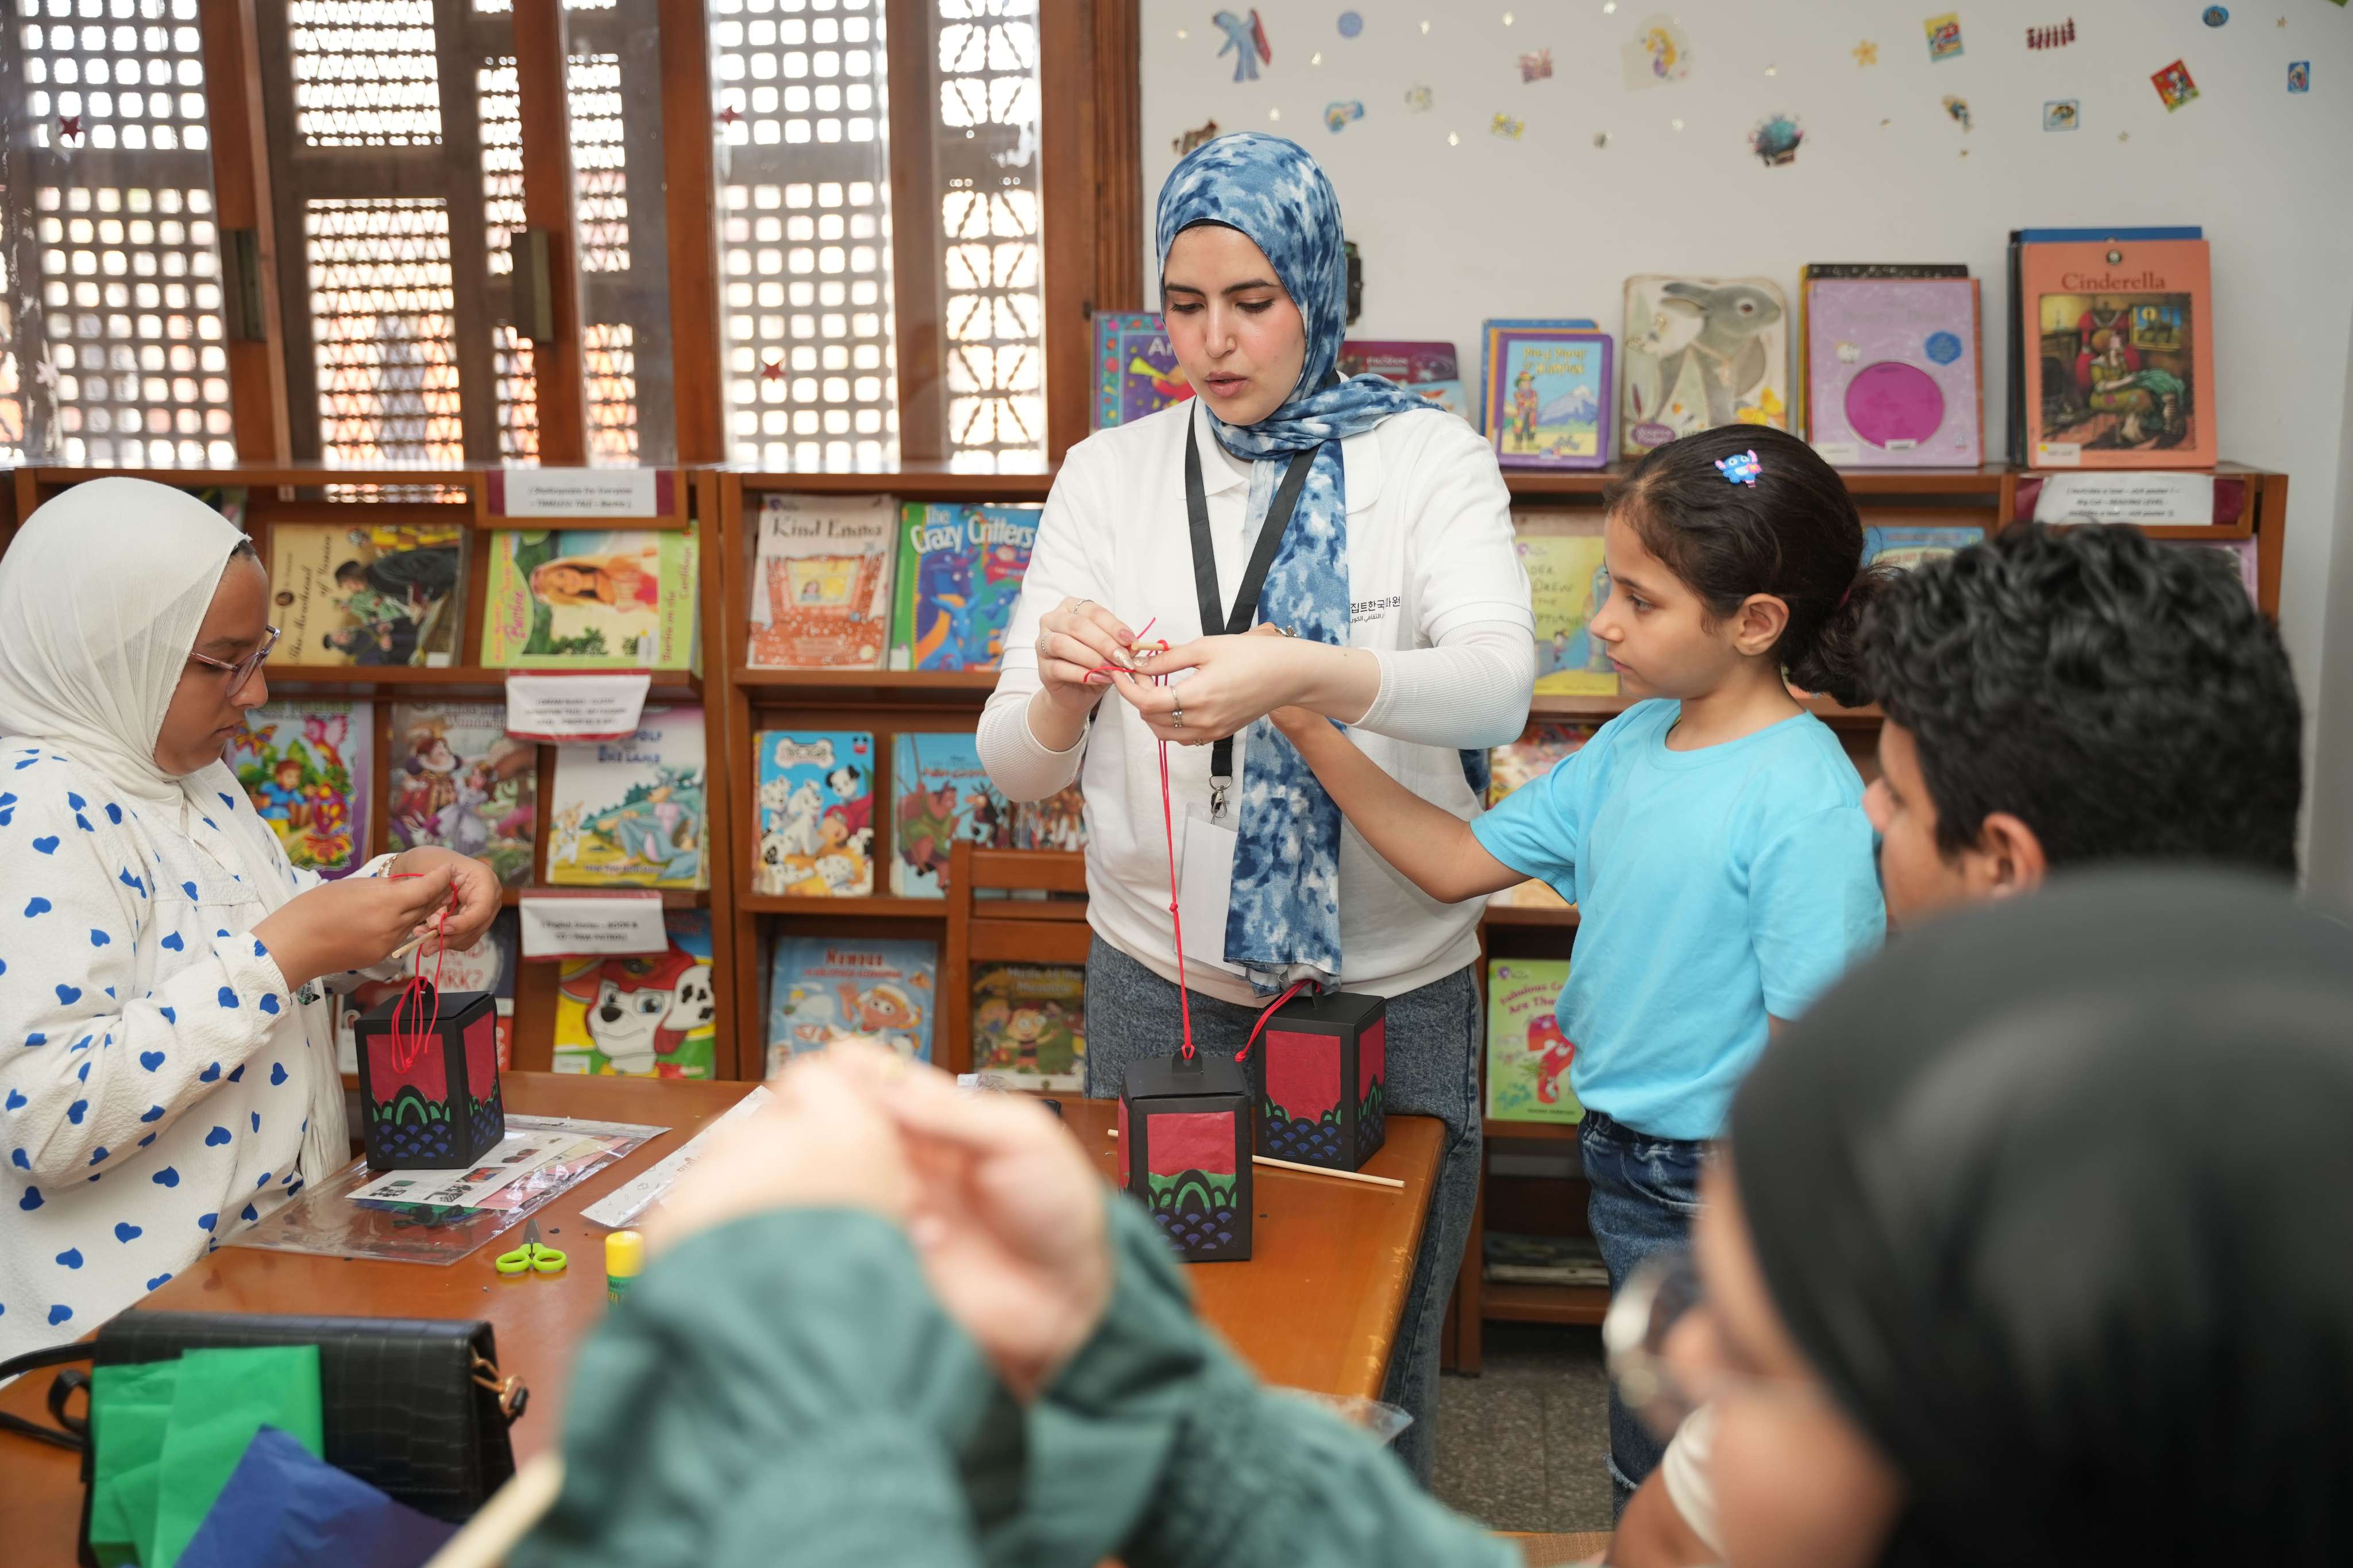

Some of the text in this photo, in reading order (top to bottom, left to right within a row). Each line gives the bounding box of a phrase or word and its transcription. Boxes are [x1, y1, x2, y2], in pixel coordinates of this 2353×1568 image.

[2061, 271, 2166, 291] Cinderella
[924, 505, 951, 526] The
[773, 516, 882, 539] Kind Emma
[910, 514, 1036, 555] Crazy Critters
[1350, 616, 1363, 624] الكور
